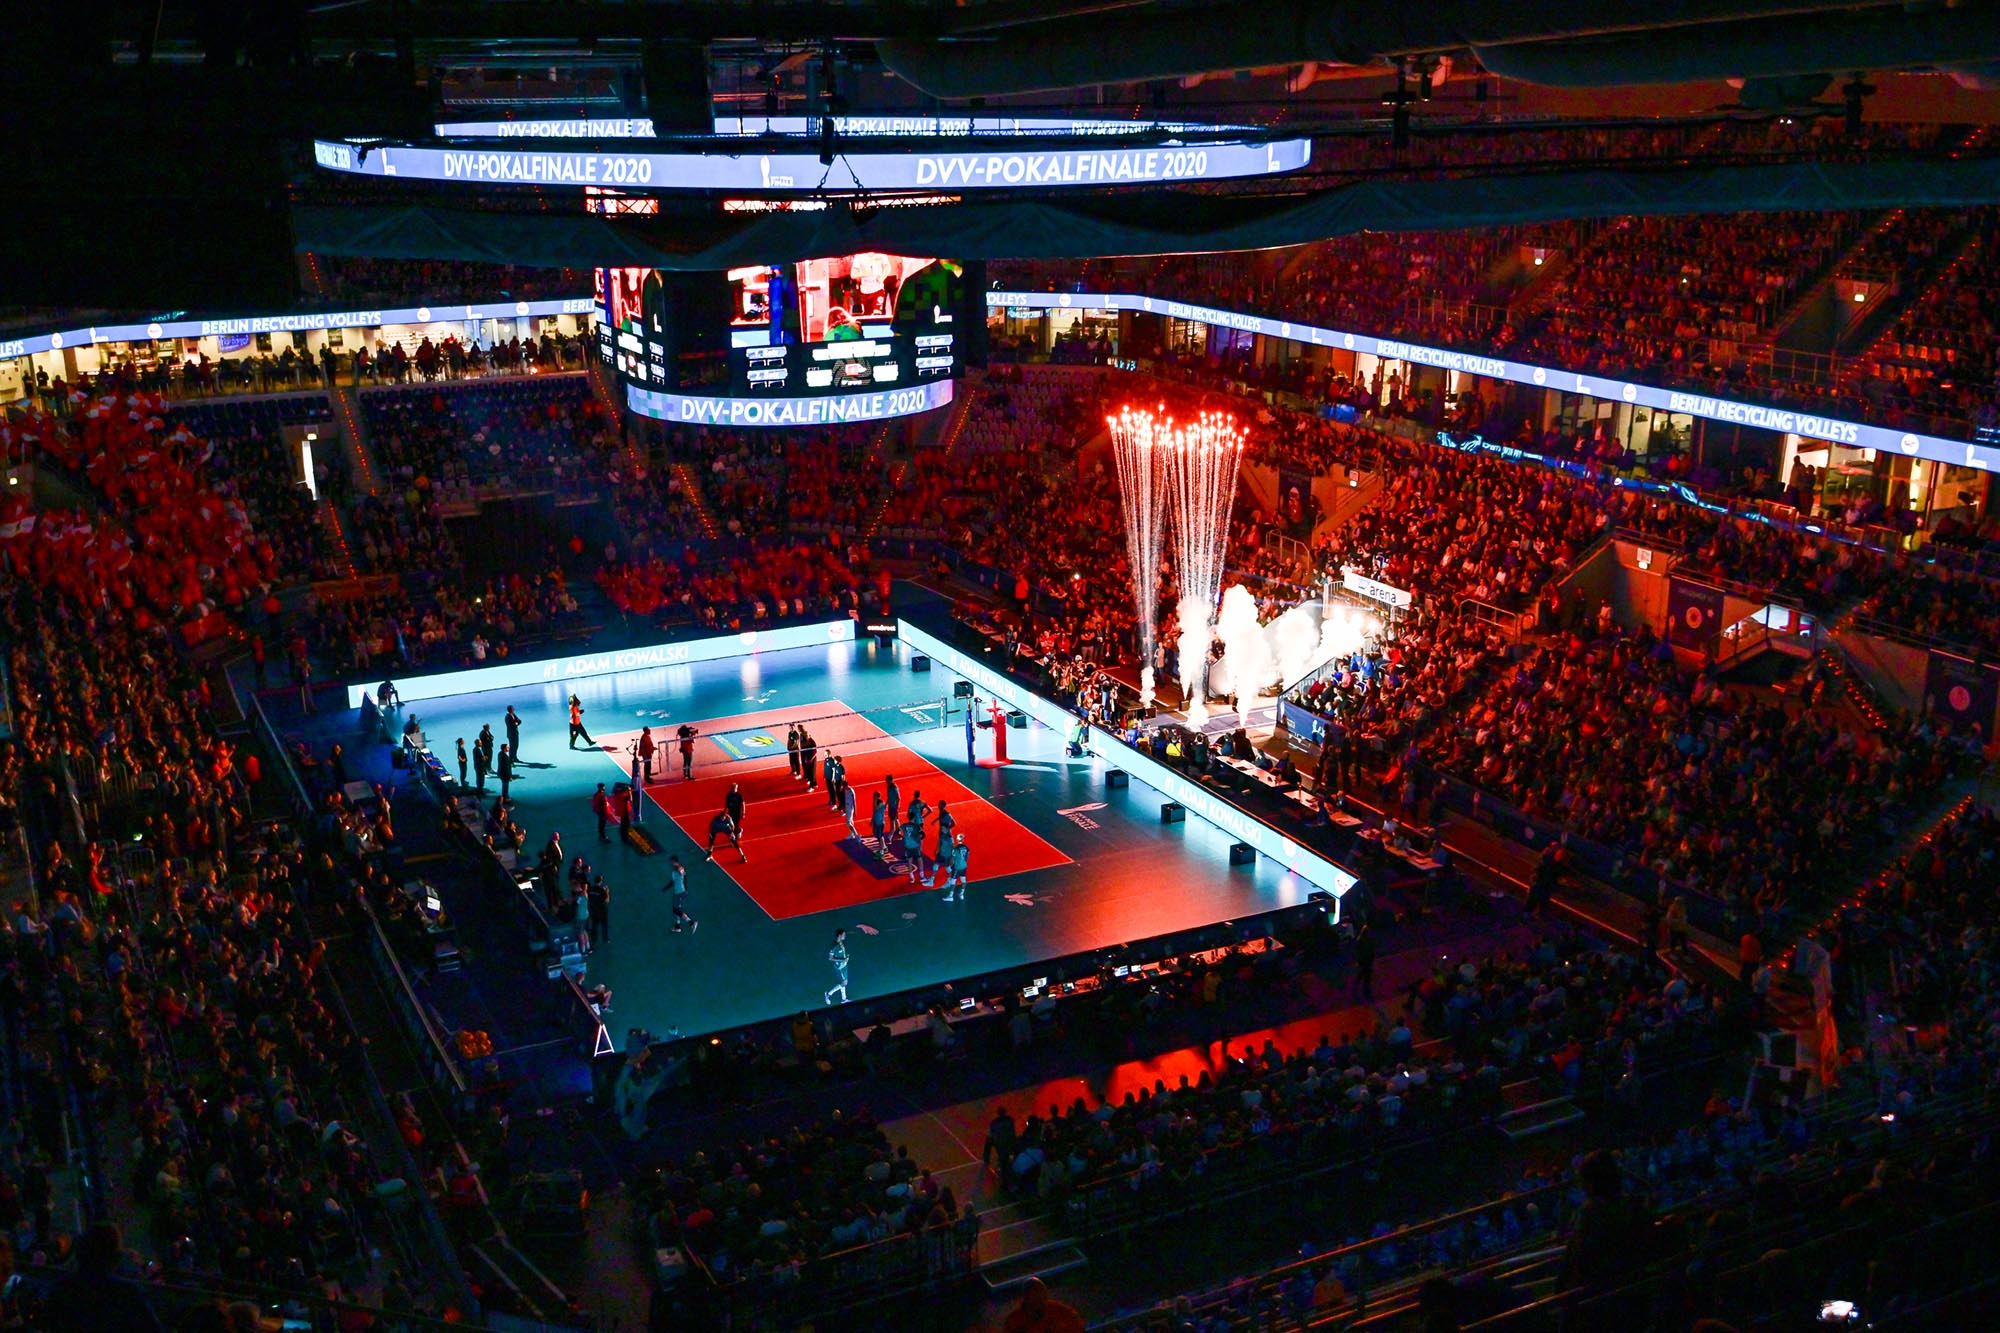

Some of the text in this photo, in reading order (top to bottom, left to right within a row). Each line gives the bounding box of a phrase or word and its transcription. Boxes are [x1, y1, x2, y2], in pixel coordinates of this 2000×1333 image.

[498, 120, 631, 137] DVV-POKALFINALE
[820, 119, 968, 137] V-POKALFINALE 2020
[444, 153, 652, 184] DVV-POKALFINALE 2020
[916, 151, 1207, 184] DVV-POKALFINALE 2020
[563, 299, 595, 312] BERLI
[1168, 302, 1261, 331] BERLIN RECYCLING VOLLEYS
[202, 312, 381, 334] BERLIN RECYCLING VOLLEYS
[0, 340, 24, 358] LEYS
[1377, 340, 1505, 376] BERLIN RECYCLING VOLLEYS
[681, 389, 925, 423] DVV-POKALFINALE 2020
[1670, 393, 1859, 442] BERLIN RECYCLING VOLLEYS
[1369, 585, 1396, 603] arena
[544, 645, 689, 681] #1 ADAM KOWALSKI
[1176, 781, 1206, 813] ADAM
[1209, 796, 1262, 846] KOWALSKI
